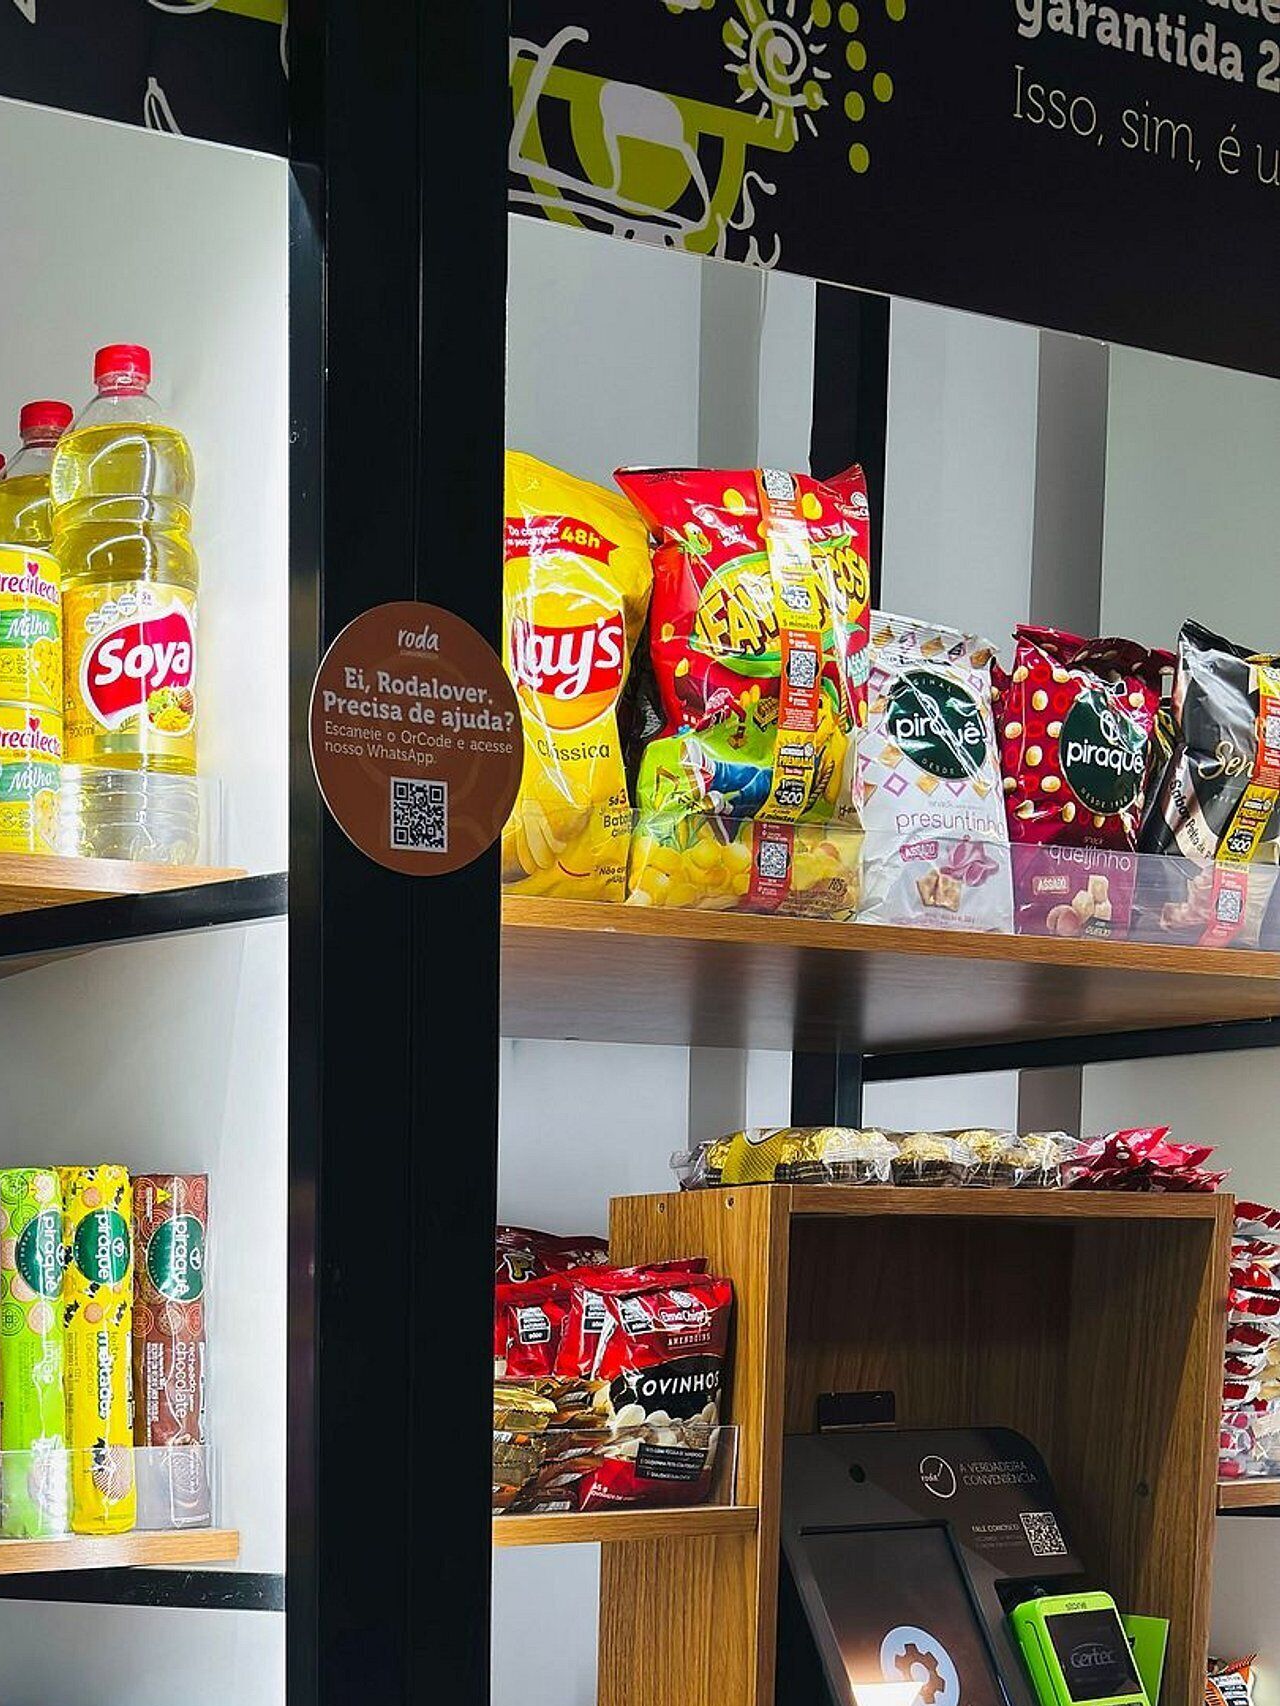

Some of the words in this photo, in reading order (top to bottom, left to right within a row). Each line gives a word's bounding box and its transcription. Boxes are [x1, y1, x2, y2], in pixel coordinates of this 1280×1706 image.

[1014, 65, 1103, 146] Isso,
[1121, 101, 1202, 172] sim,
[1219, 124, 1241, 174] é
[397, 625, 440, 651] roda
[94, 637, 191, 692] Soya
[513, 616, 623, 701] Lay's
[344, 666, 371, 693] Ei,
[377, 671, 493, 705] Rodalover.
[323, 690, 403, 722] Precisa
[409, 702, 435, 725] de
[442, 707, 515, 733] ajuda?
[324, 720, 382, 742] Escaneie
[387, 731, 396, 743] o
[401, 730, 452, 751] QrCode
[457, 739, 465, 751] e
[469, 739, 514, 755] acesse
[324, 740, 363, 757] nosso
[366, 743, 437, 767] WhatsApp.
[1066, 740, 1145, 777] piraquê
[779, 790, 803, 805] 500
[895, 808, 1006, 837] presuntinho
[1049, 845, 1131, 873] queijinho
[94, 1212, 110, 1283] piraquê
[173, 1221, 191, 1296] piraquê
[175, 1341, 188, 1419] chocolate
[642, 1371, 719, 1397] OVINHOS
